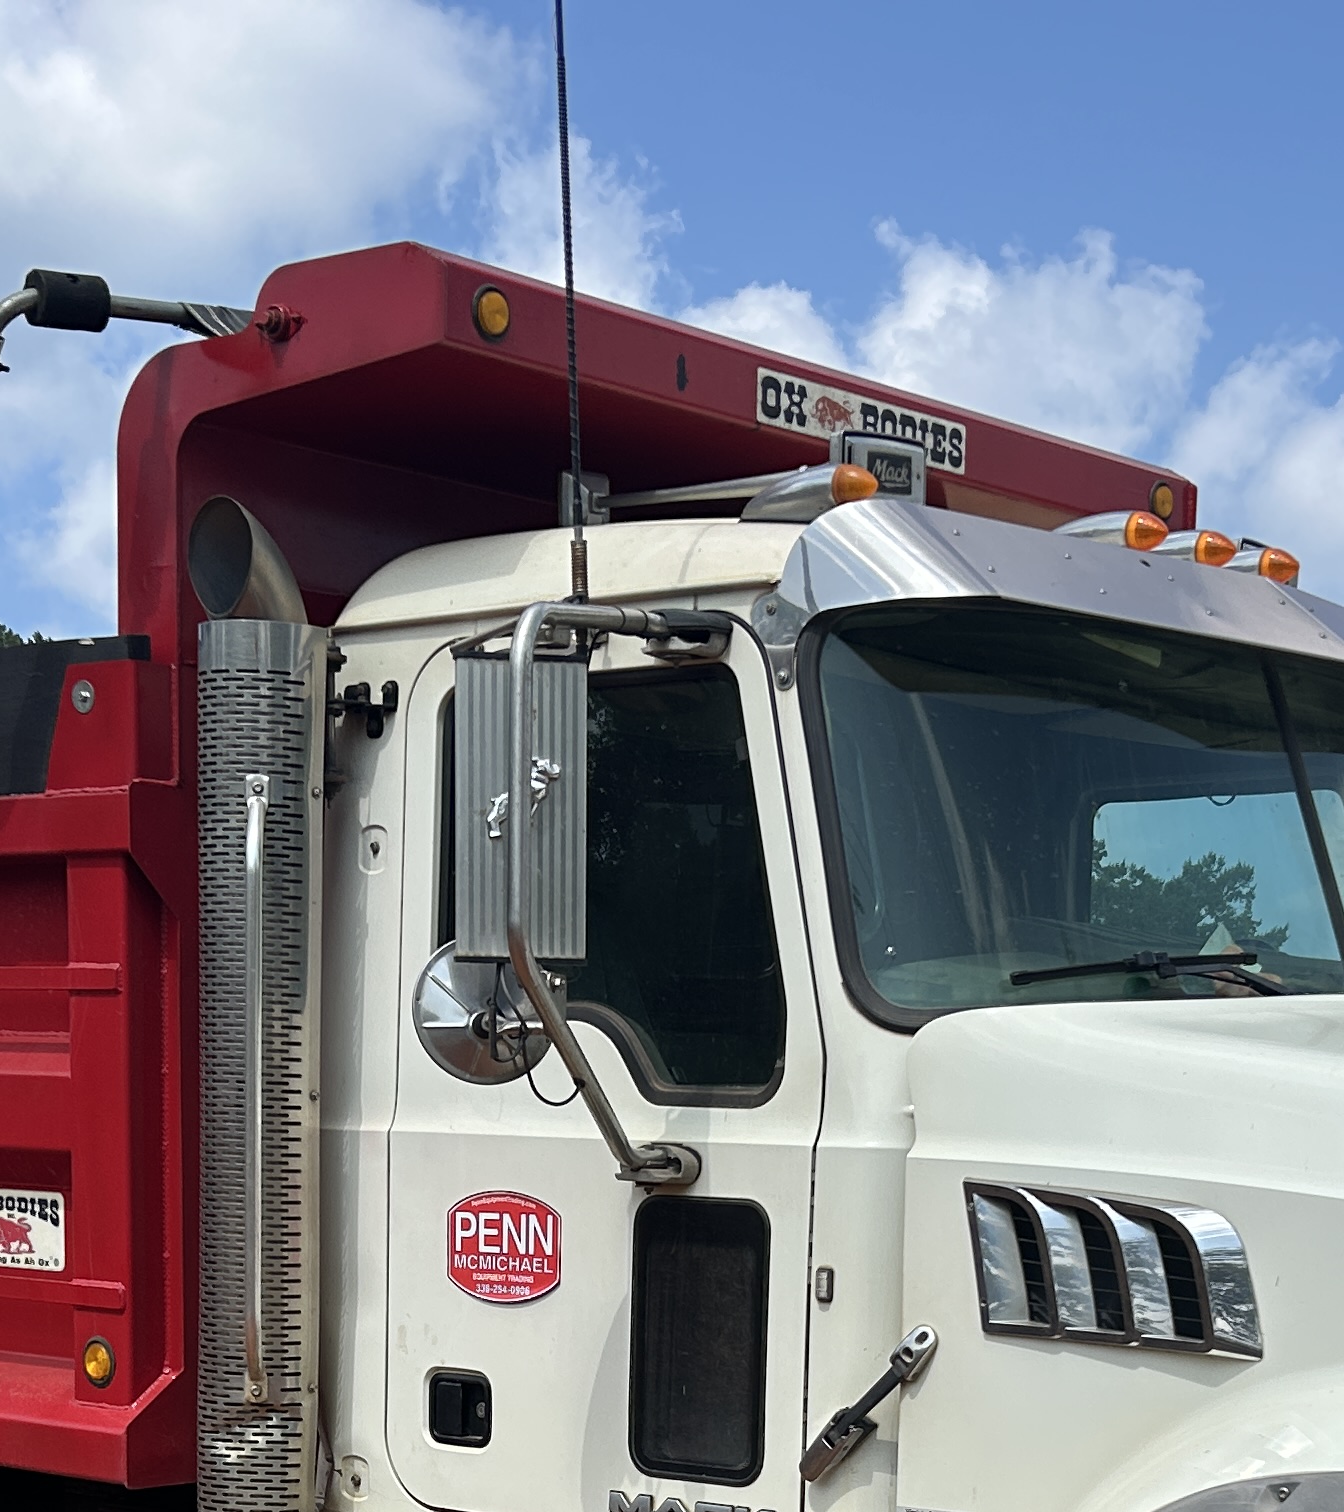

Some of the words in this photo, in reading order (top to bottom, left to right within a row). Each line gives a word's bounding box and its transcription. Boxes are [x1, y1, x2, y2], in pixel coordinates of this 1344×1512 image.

[761, 376, 808, 427] OX
[860, 402, 964, 468] BODIES
[870, 458, 911, 486] Mack
[455, 1211, 554, 1256] PENN
[10, 1256, 21, 1265] As
[454, 1254, 554, 1274] MCMICHAEL
